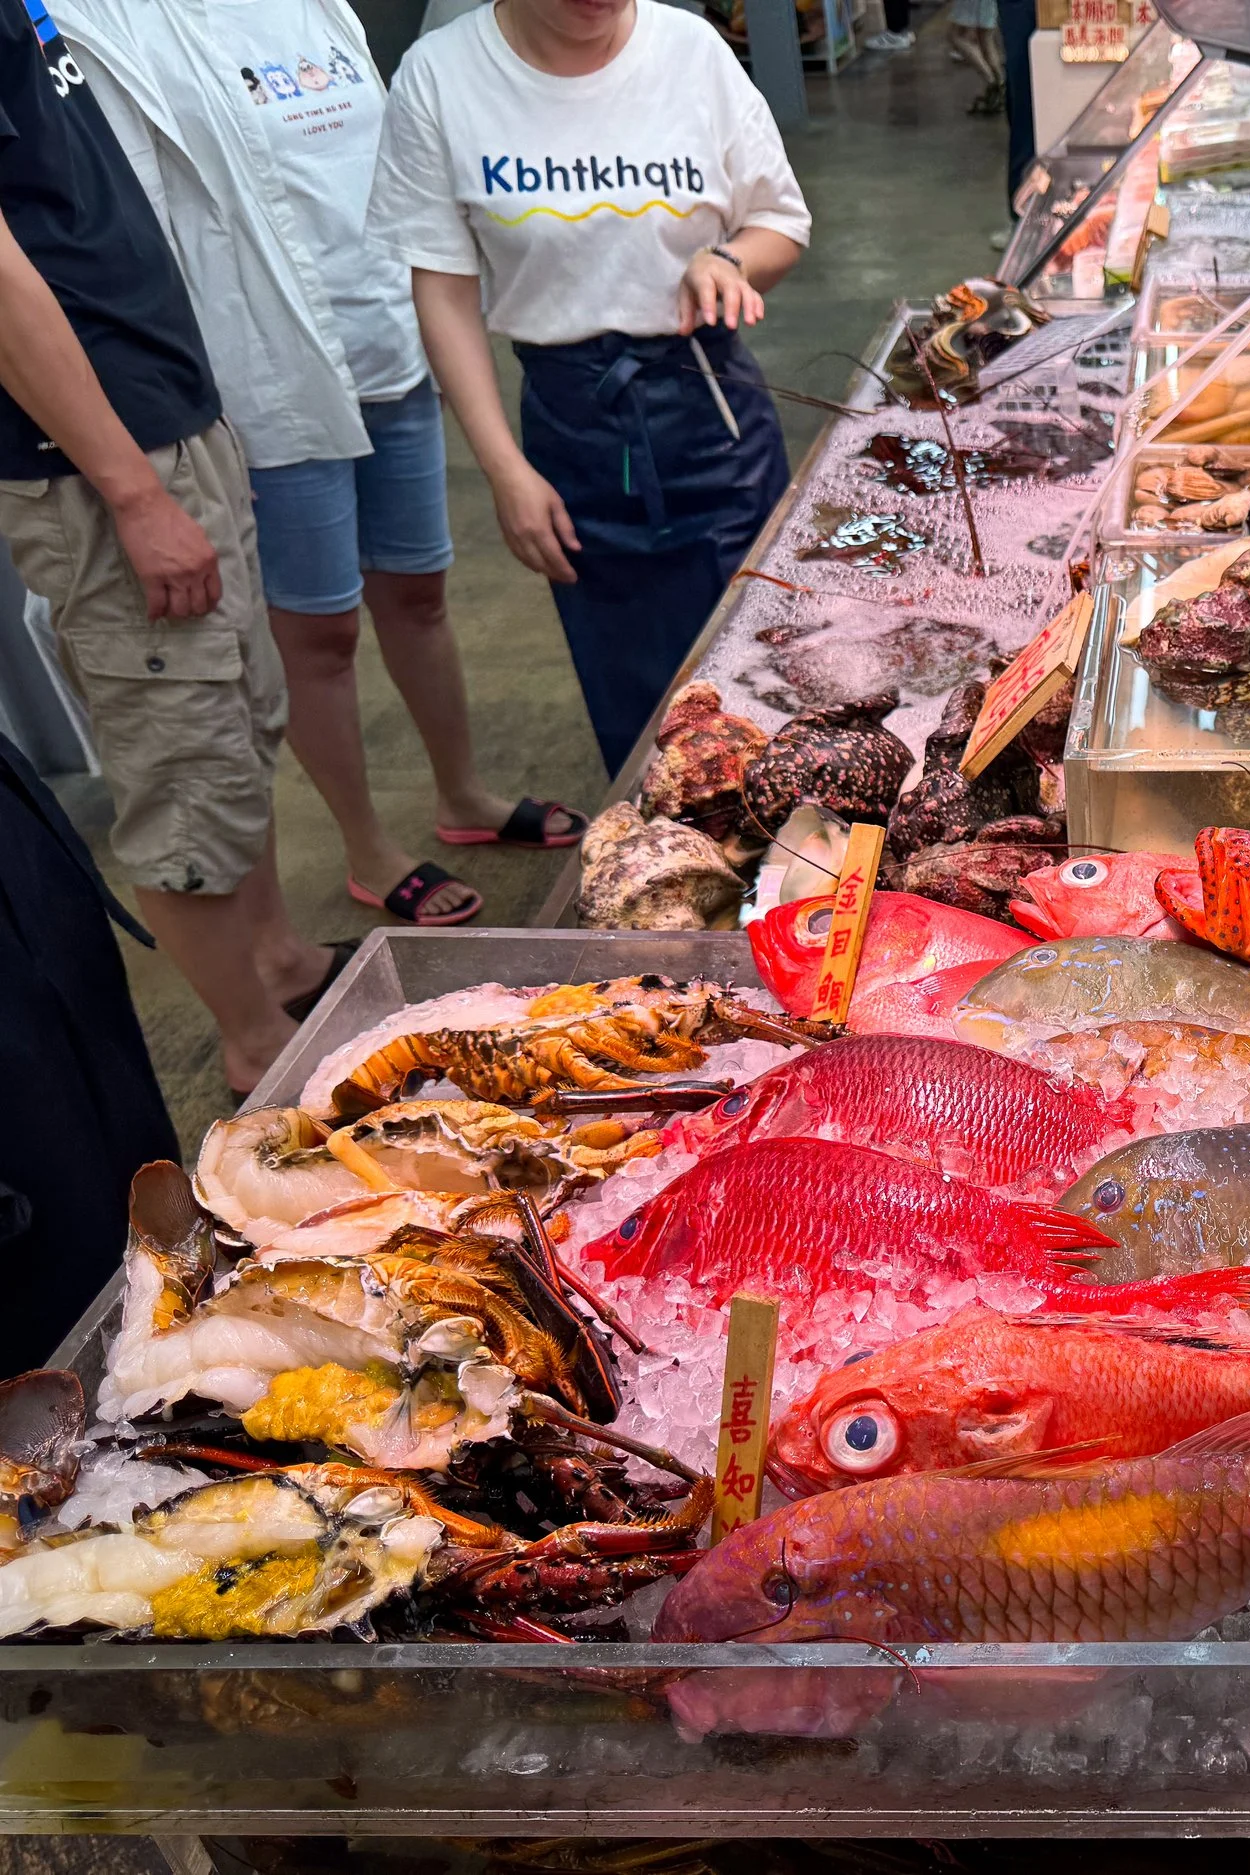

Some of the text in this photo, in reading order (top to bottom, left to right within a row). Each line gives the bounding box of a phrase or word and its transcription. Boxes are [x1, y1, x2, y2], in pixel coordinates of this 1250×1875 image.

[307, 124, 327, 135] LOVE
[328, 120, 344, 129] YOU
[481, 155, 705, 197] Kbhtkhqtb
